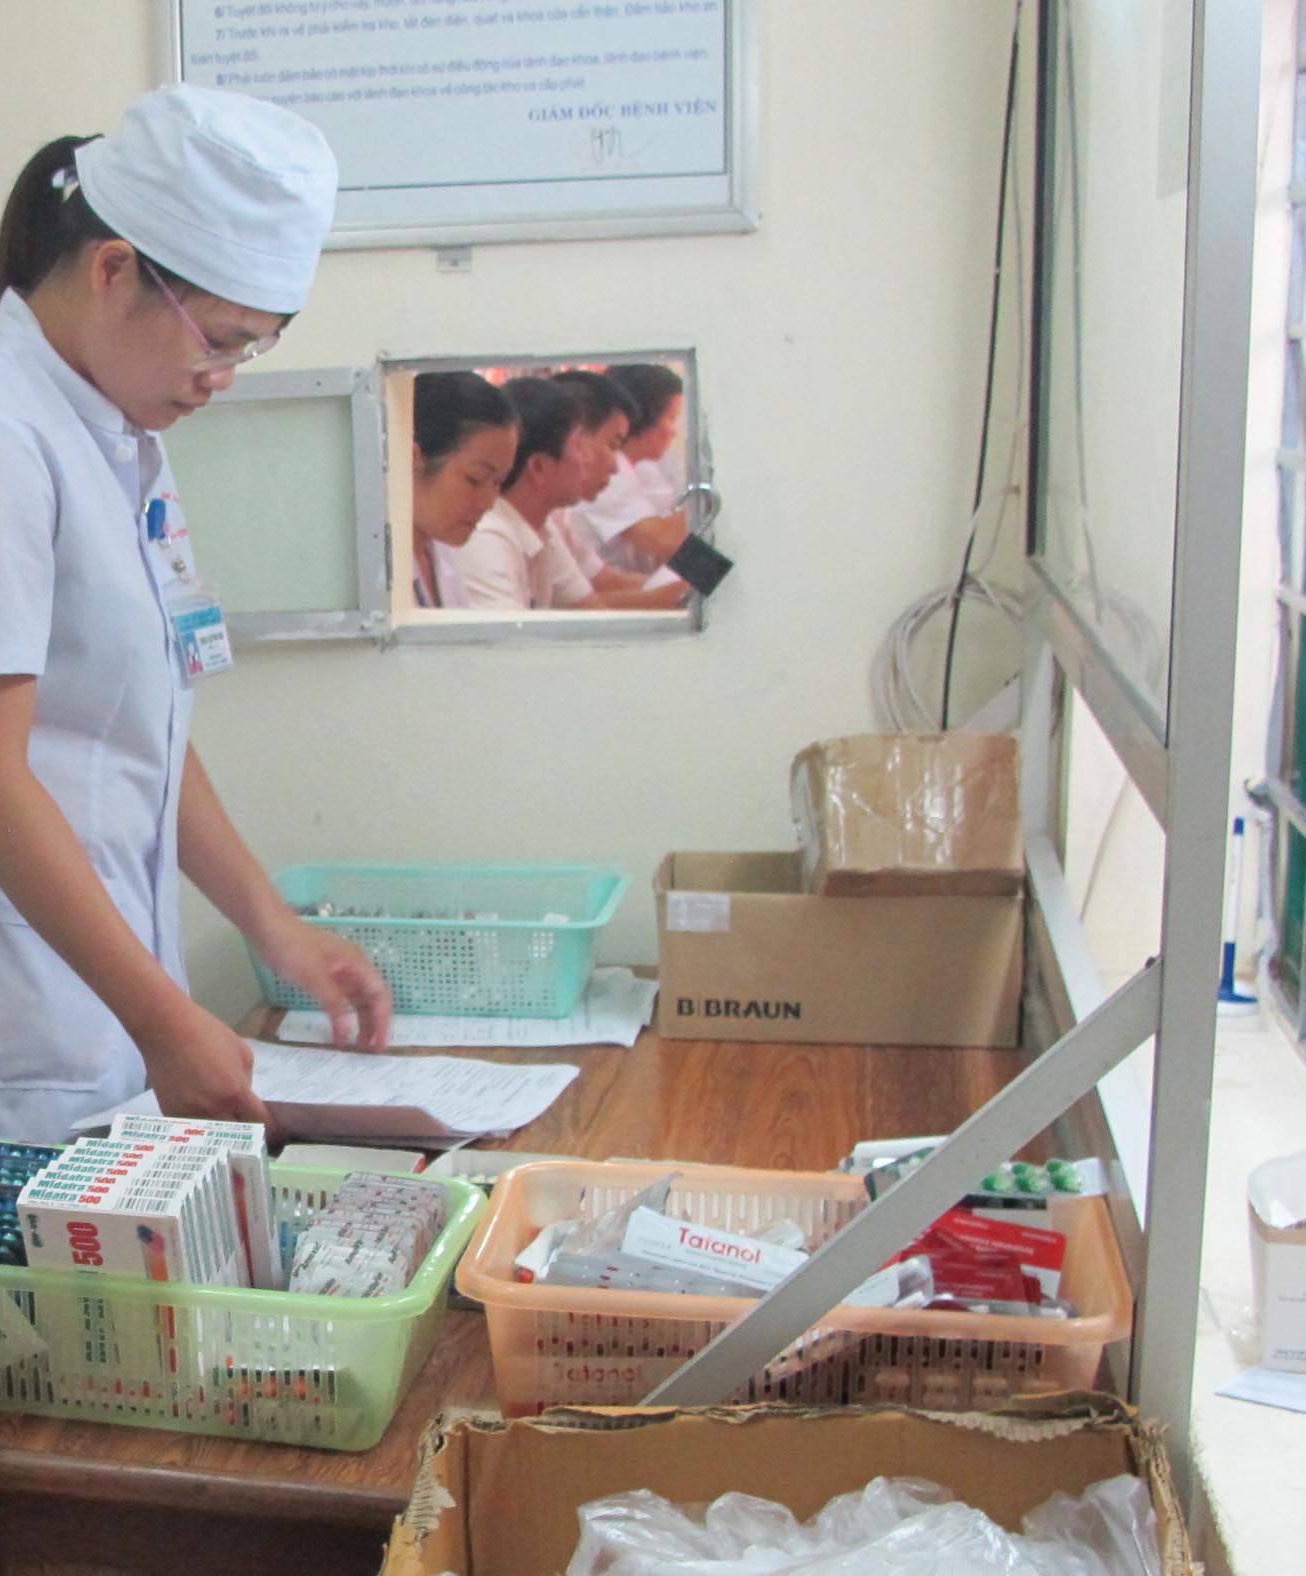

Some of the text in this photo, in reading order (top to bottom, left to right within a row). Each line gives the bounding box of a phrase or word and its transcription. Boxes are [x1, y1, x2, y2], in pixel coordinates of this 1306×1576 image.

[677, 998, 801, 1019] B BRAUN
[85, 1139, 132, 1150] Midafra
[74, 1148, 120, 1158] Midafra
[68, 1156, 115, 1166] Midafra
[57, 1163, 105, 1174] Midafra
[45, 1171, 93, 1183] Midafra
[37, 1180, 86, 1192] Midafra
[29, 1188, 78, 1201] Midafra
[65, 1220, 104, 1267] 500
[677, 1226, 761, 1264] Tatanol
